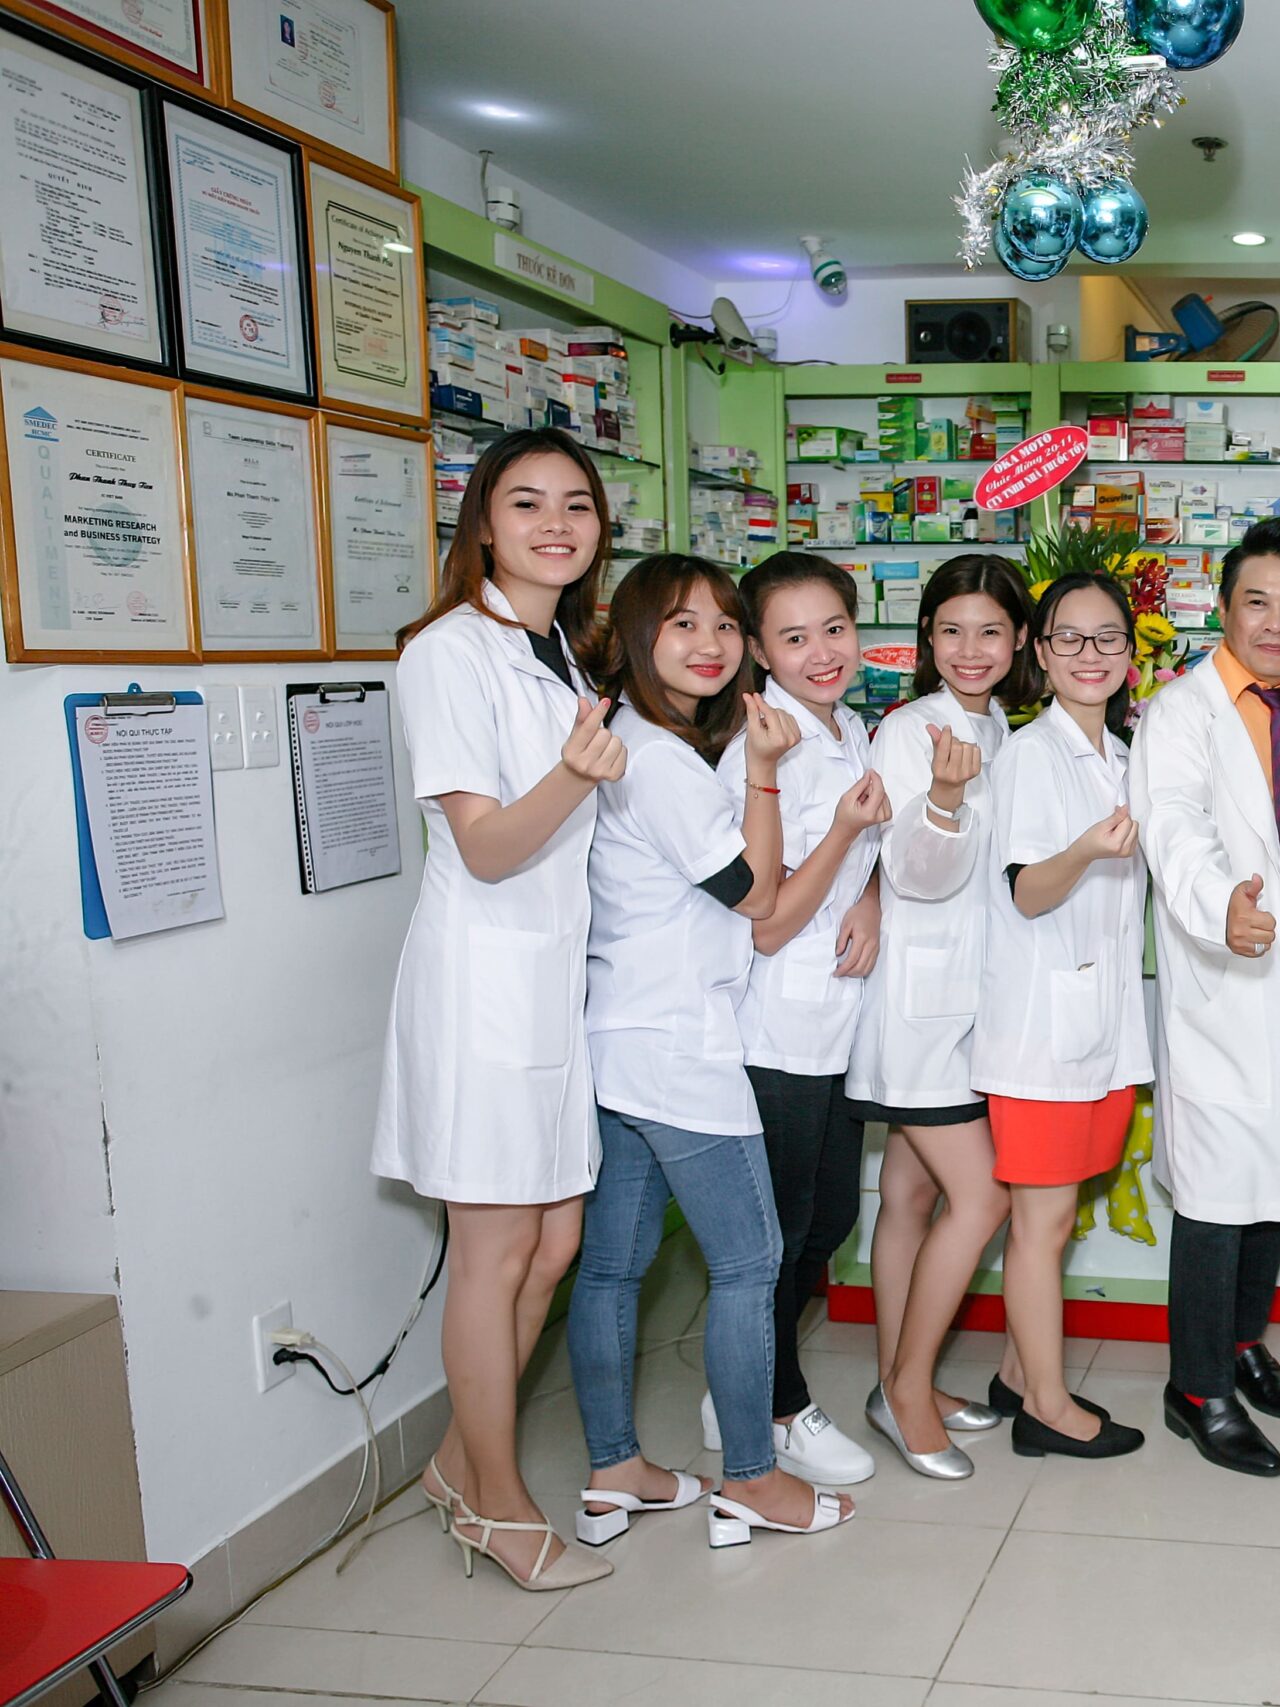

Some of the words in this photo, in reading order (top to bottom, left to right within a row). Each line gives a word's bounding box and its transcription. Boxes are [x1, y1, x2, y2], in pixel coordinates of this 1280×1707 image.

[24, 419, 57, 430] SMEDEC
[1044, 434, 1072, 456] 20-11
[85, 448, 137, 463] CERTIFICATE
[993, 454, 1020, 474] OKA
[1019, 433, 1052, 458] MOTO
[986, 491, 1003, 509] CTY
[1002, 481, 1026, 499] TNHH
[1041, 450, 1070, 474] THUỐC
[1068, 439, 1086, 457] TỐT
[64, 514, 114, 527] MARKETING
[115, 519, 157, 531] RESEARCH
[80, 530, 120, 541] BUSINESS
[122, 534, 161, 545] STRATEGY
[128, 729, 140, 737] QUI
